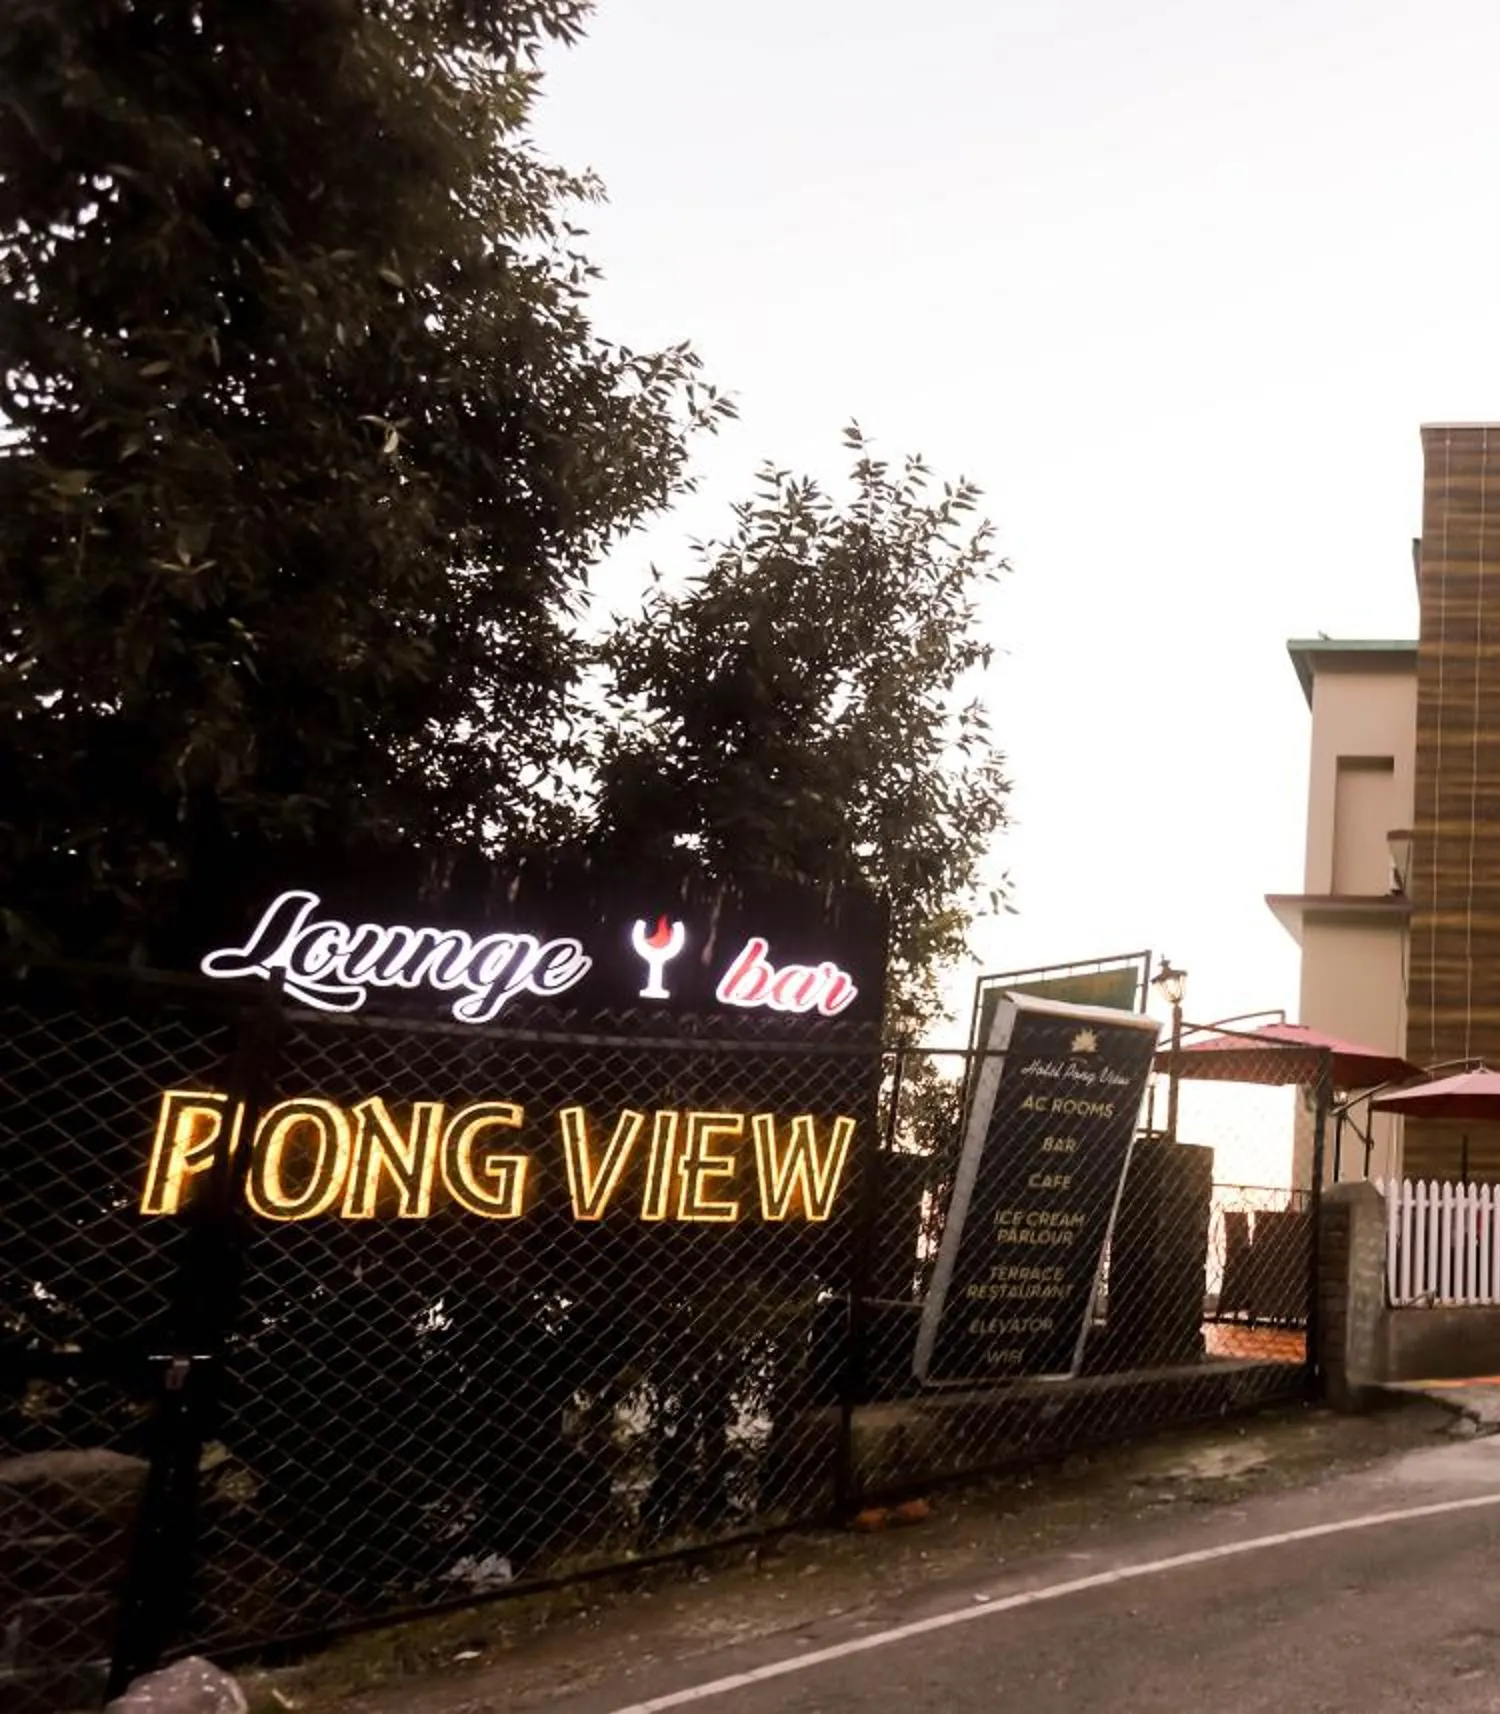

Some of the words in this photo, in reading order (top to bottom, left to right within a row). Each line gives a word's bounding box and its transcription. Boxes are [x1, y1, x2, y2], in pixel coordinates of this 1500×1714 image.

[200, 890, 592, 1023] Lounge
[716, 936, 858, 1016] bar
[1022, 1095, 1048, 1111] AC
[1051, 1098, 1116, 1118] ROOMS
[1042, 1136, 1077, 1153] BAR
[139, 1090, 525, 1221] PONG
[559, 1109, 855, 1221] VIEW
[1028, 1173, 1073, 1189] CAFE
[994, 1209, 1023, 1225] ICE
[1026, 1210, 1085, 1227] CREAM
[997, 1228, 1074, 1245] PARLOUR
[990, 1265, 1065, 1281] TERRACE
